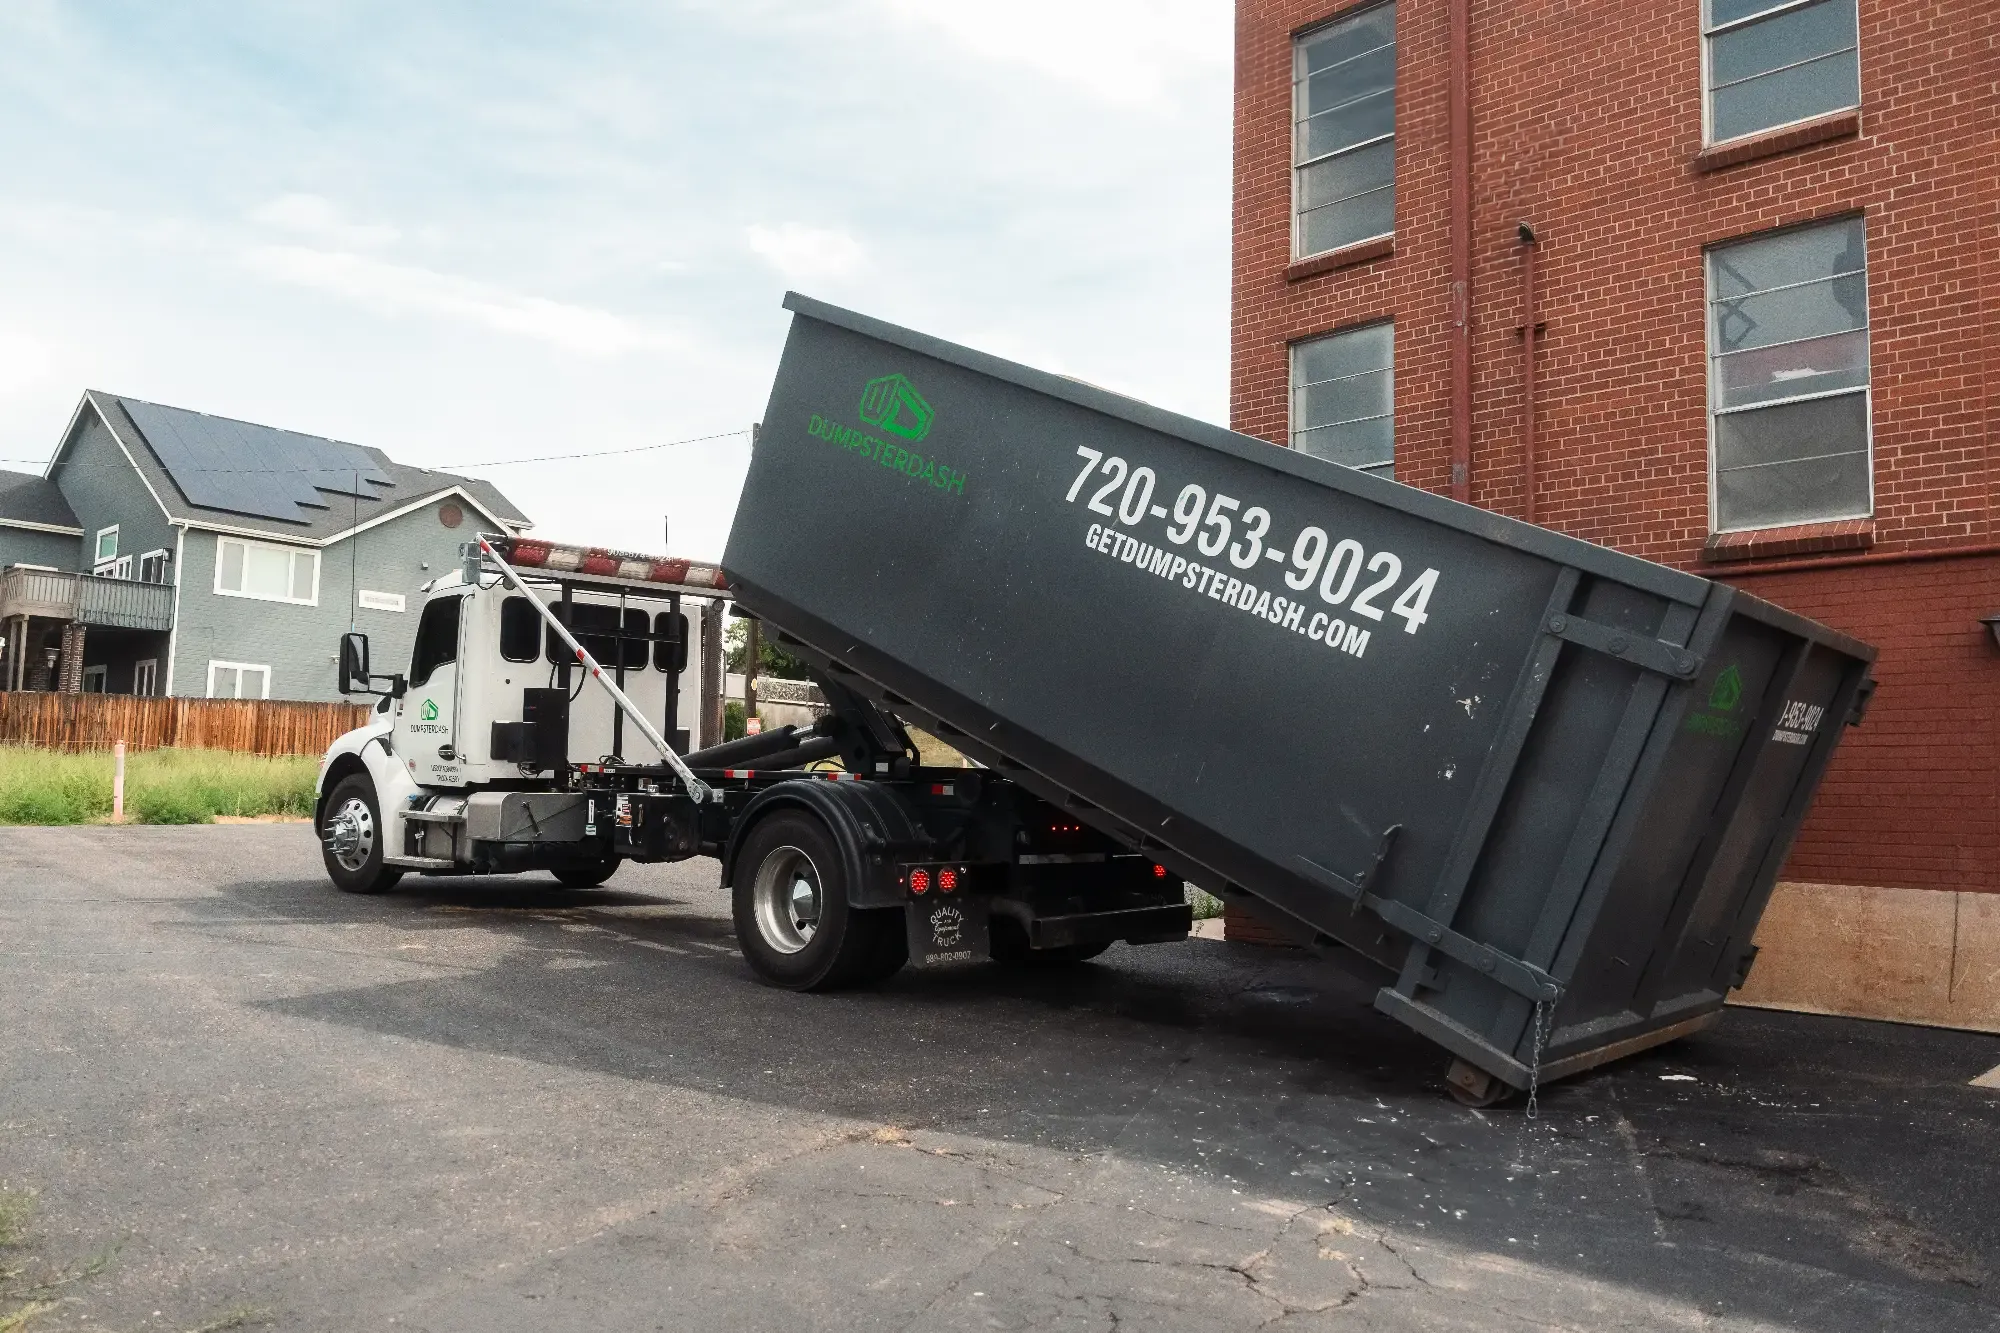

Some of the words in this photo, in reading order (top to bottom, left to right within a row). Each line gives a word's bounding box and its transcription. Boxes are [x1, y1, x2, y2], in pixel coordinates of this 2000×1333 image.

[807, 413, 967, 496] DUMPSTERDASH
[1065, 445, 1441, 635] 720-953-9024
[1085, 523, 1371, 658] GETDUMPSTERDASH.COM
[930, 906, 964, 924] QUALITY
[932, 930, 962, 947] TRUCK
